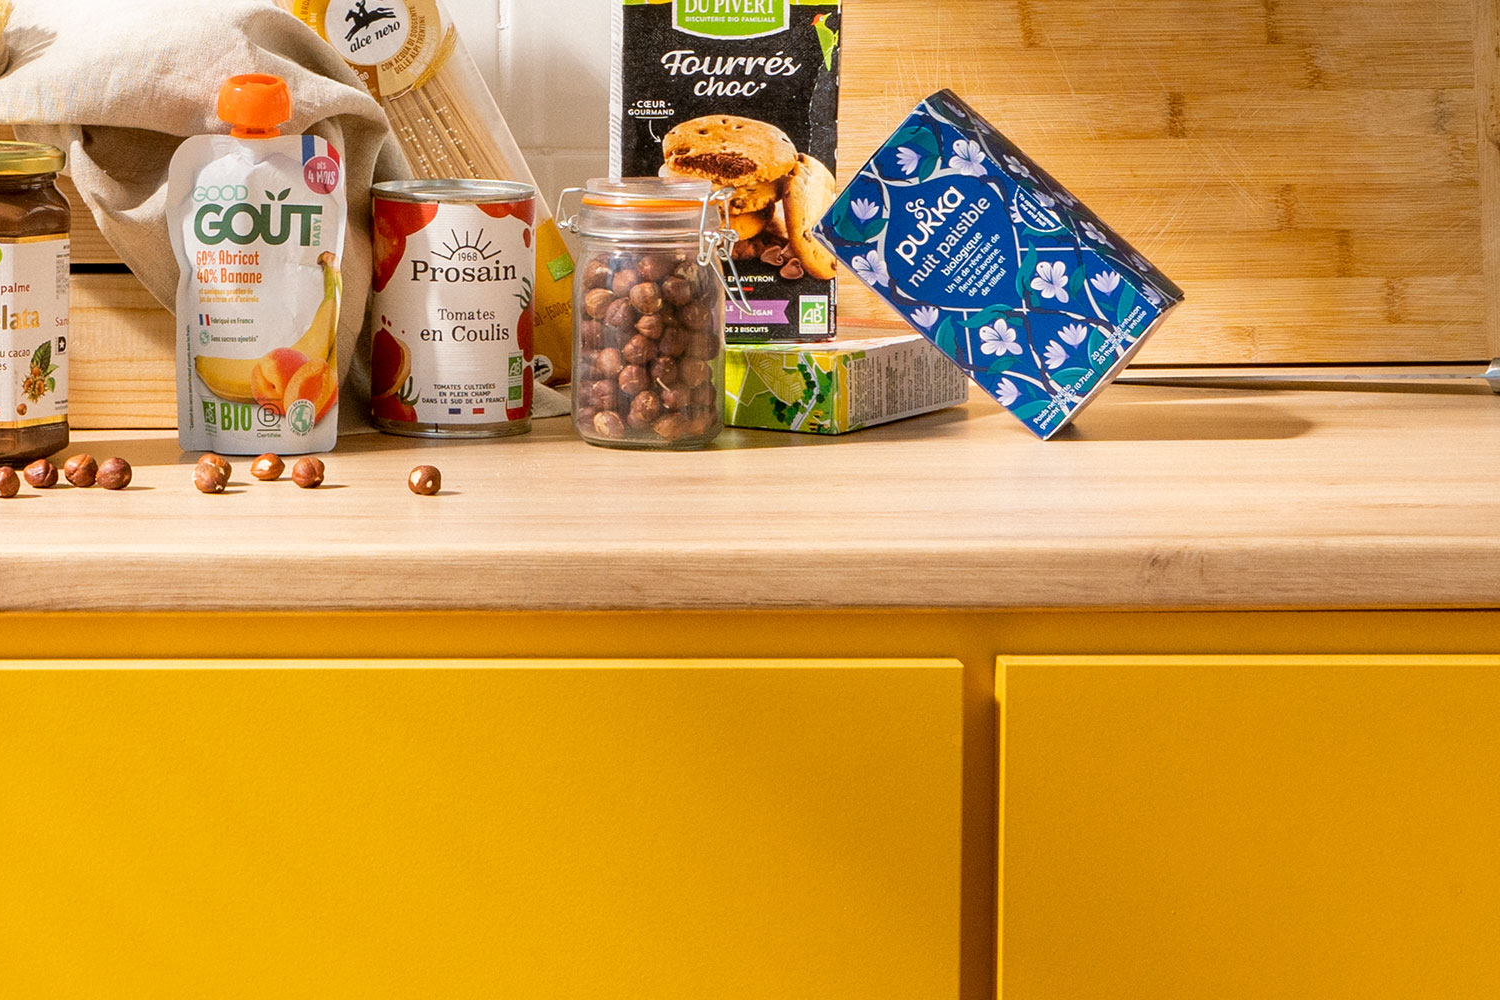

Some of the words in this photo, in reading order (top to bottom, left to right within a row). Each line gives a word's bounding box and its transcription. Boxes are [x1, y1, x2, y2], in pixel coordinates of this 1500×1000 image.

[350, 35, 372, 53] alce
[375, 21, 401, 40] nero
[381, 61, 394, 72] CON
[394, 46, 411, 64] ACQUA
[394, 56, 413, 75] DELLE
[660, 50, 801, 77] Fourrés
[308, 170, 315, 183] 4
[316, 171, 336, 186] MOIS
[192, 184, 248, 202] GOOD
[312, 217, 322, 246] BABY
[895, 185, 965, 266] pukka
[908, 254, 941, 288] nuit
[936, 197, 991, 258] paisible
[196, 250, 216, 266] 60%
[218, 250, 259, 266] Abricot
[458, 252, 478, 262] 1968
[940, 232, 983, 276] biologique
[944, 282, 957, 294] Un
[953, 275, 964, 285] lit
[961, 266, 971, 277] de
[968, 252, 984, 268] rêve
[980, 242, 993, 255] fait
[990, 233, 1001, 243] de
[196, 267, 218, 284] 40%
[220, 268, 262, 284] Banane
[411, 259, 517, 282] Prosain
[967, 286, 978, 297] de
[974, 262, 1000, 288] lavande
[997, 255, 1006, 264] et
[1, 282, 30, 295] palme
[958, 274, 977, 293] fleurs
[980, 286, 991, 296] de
[988, 267, 1007, 288] tilleul
[437, 308, 495, 320] Tomates
[802, 308, 822, 322] AB
[420, 328, 443, 341] en
[452, 323, 509, 342] Coulis
[1096, 355, 1106, 365] 20
[1128, 310, 1148, 330] infusie
[8, 350, 30, 358] cacao
[1091, 351, 1100, 361] 20
[220, 402, 252, 431] BIO
[1033, 408, 1050, 424] Poids
[1039, 407, 1061, 430] gewicht
